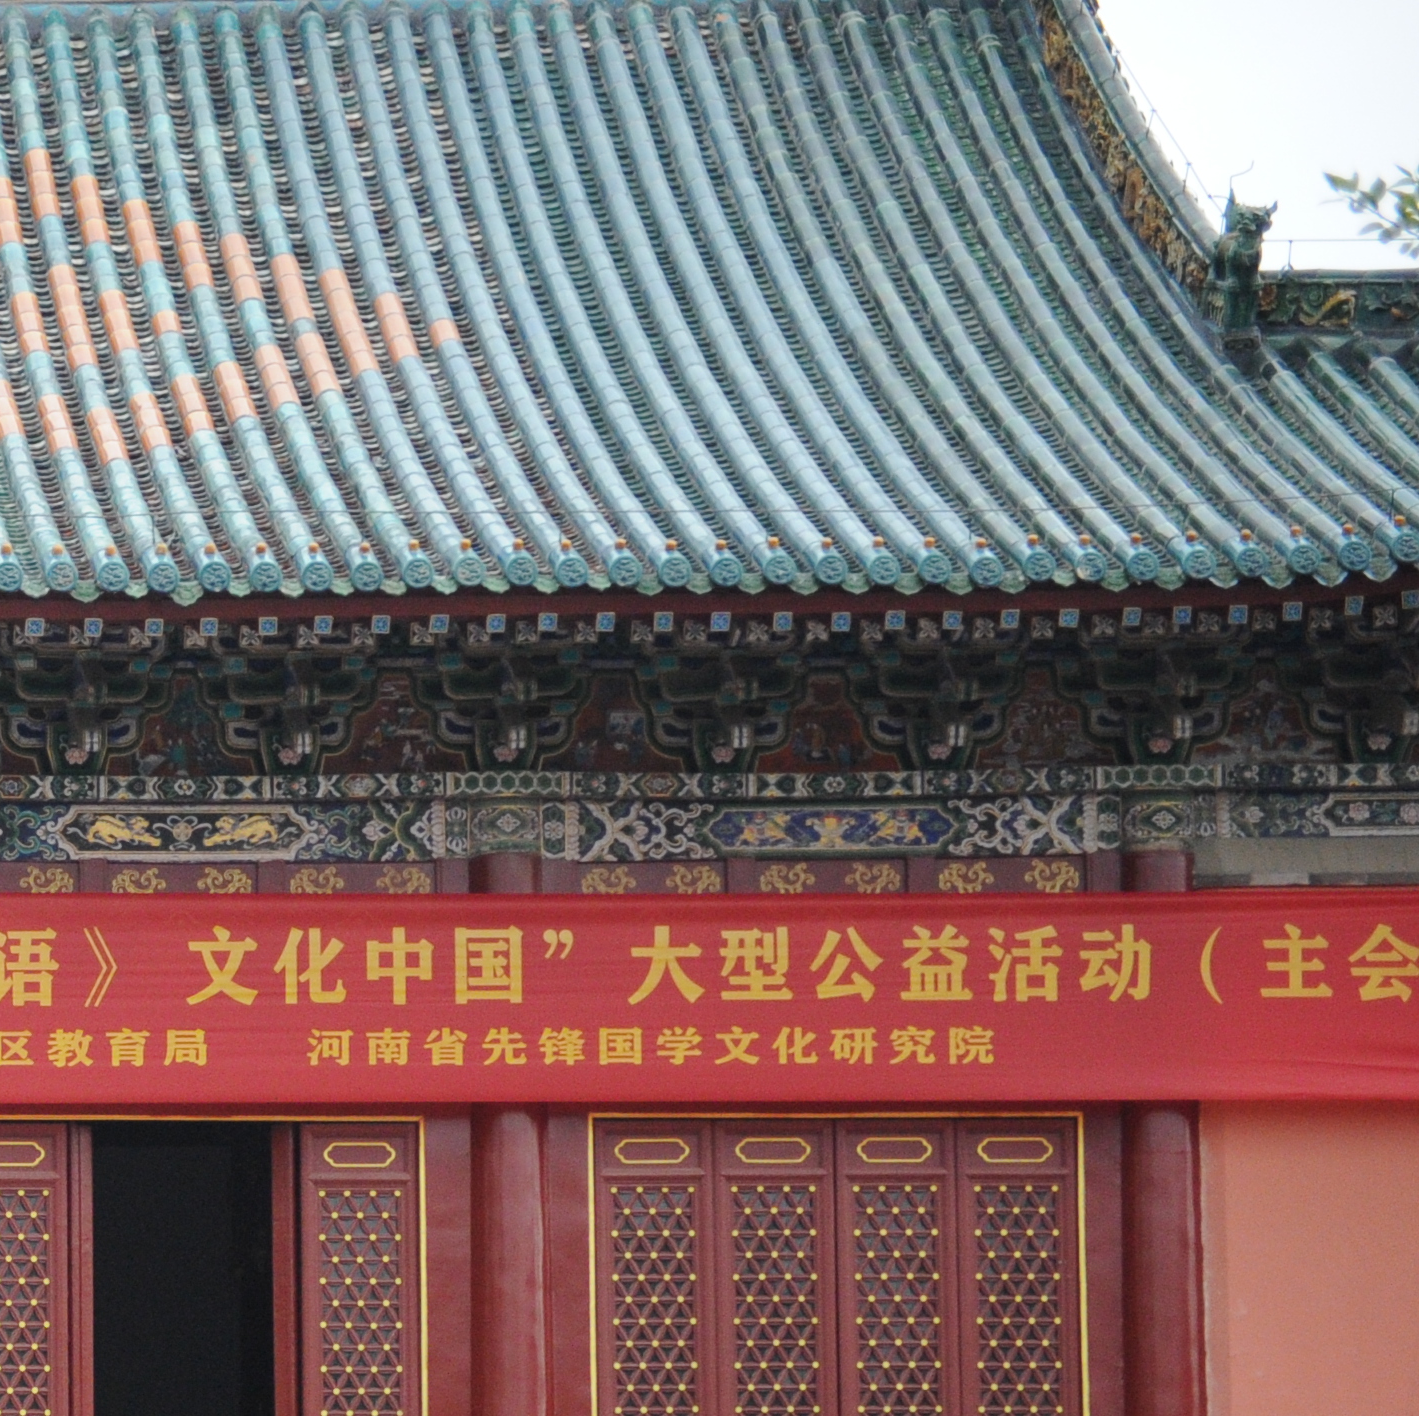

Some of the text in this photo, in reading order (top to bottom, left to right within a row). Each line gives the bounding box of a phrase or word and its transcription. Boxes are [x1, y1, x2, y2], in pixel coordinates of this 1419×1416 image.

[307, 1025, 995, 1067] 河南省先锋国学文化研究院
